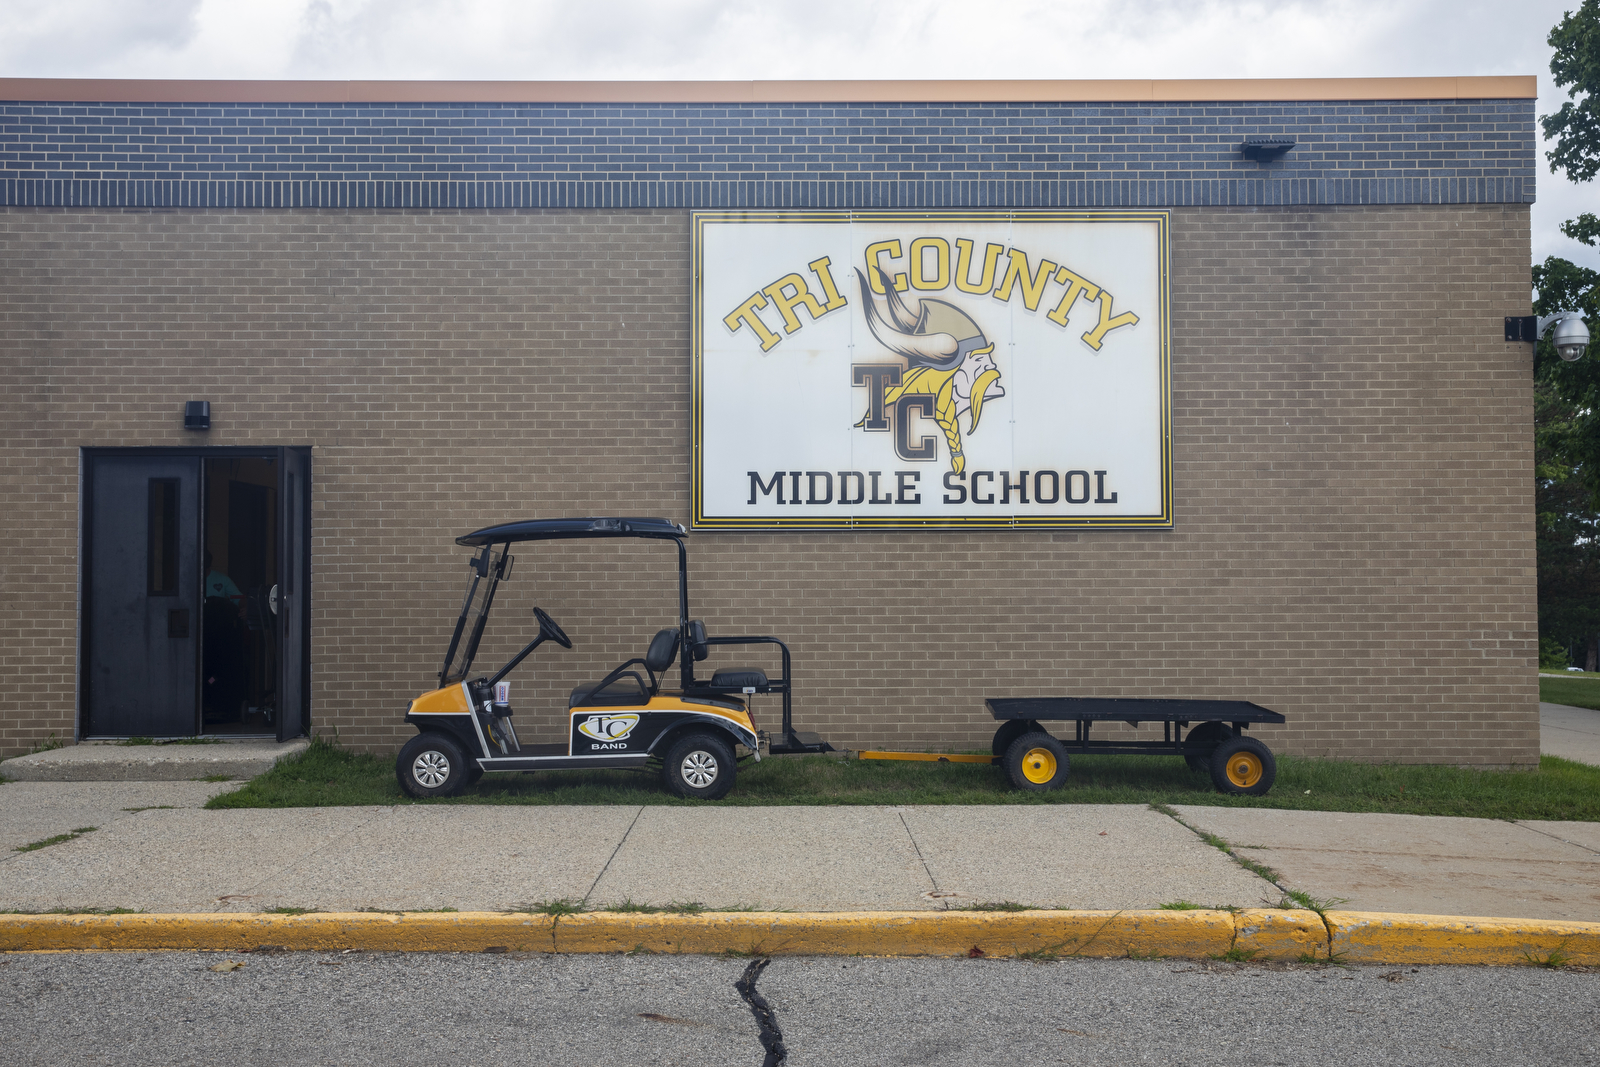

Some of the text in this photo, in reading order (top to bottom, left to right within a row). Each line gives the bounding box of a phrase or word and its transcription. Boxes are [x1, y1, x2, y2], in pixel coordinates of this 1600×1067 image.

[722, 237, 1141, 353] TRI COUNTY
[851, 363, 937, 462] TC
[747, 470, 1118, 505] MIDDLE SCHOOL
[590, 716, 628, 738] TC
